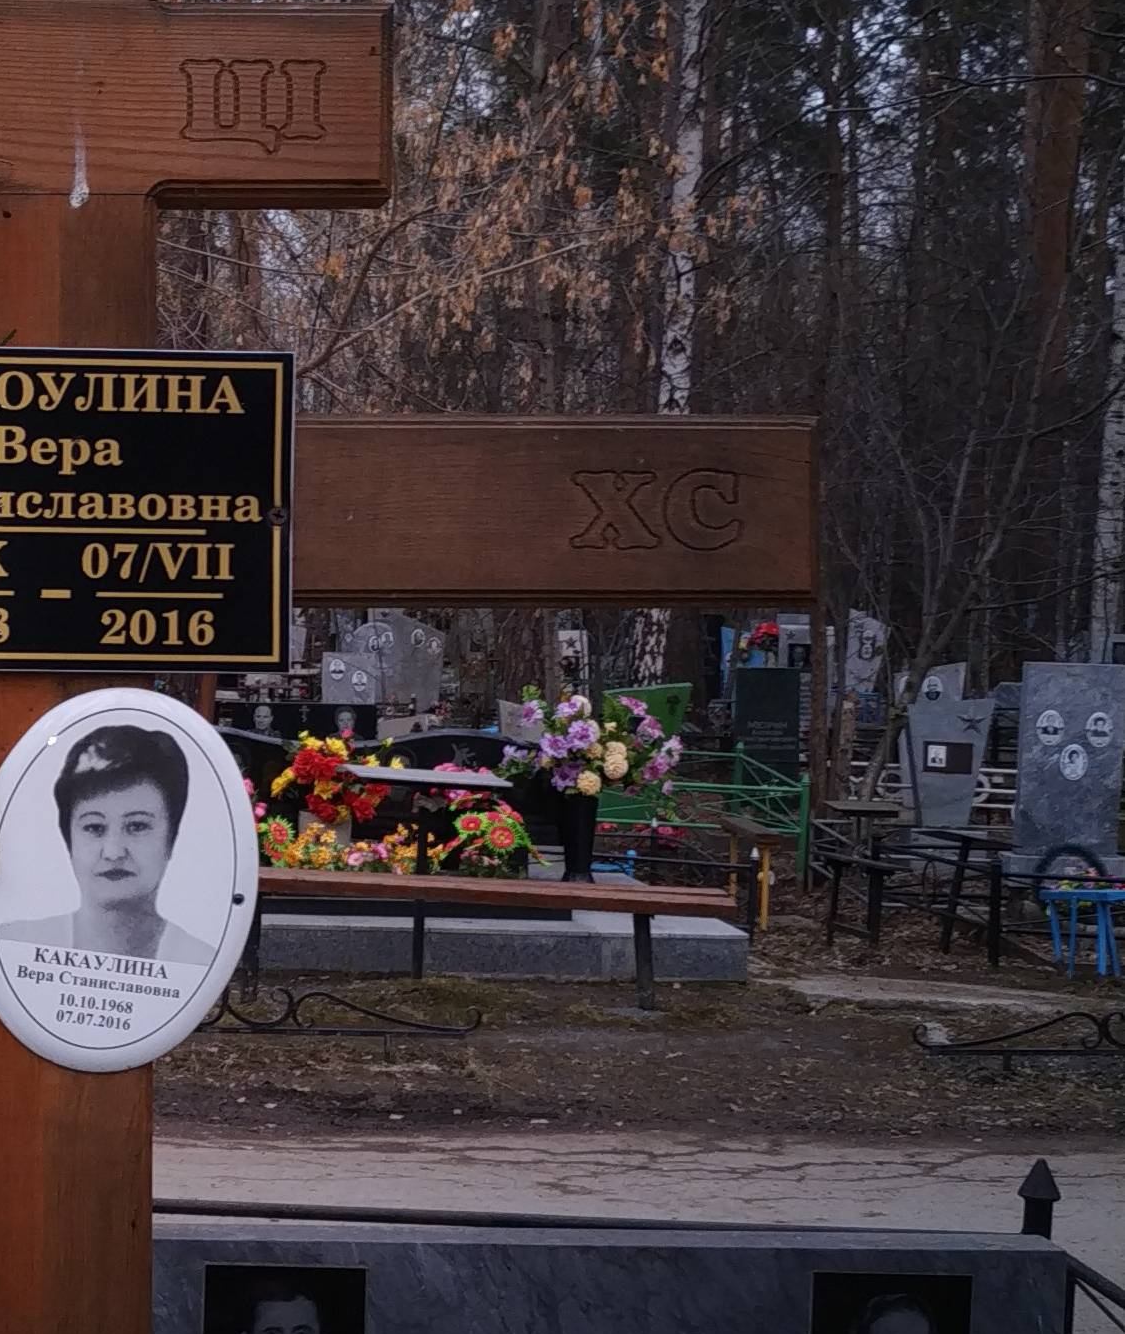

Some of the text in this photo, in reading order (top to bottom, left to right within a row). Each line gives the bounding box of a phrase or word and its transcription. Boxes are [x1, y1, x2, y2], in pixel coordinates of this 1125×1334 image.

[100, 609, 215, 646] 2016
[34, 947, 168, 979] КАКАУЛИНА
[17, 965, 180, 999] Вера Станиславовна
[58, 993, 133, 1014] 10.10.1968
[56, 1010, 131, 1031] 07.07.2016
